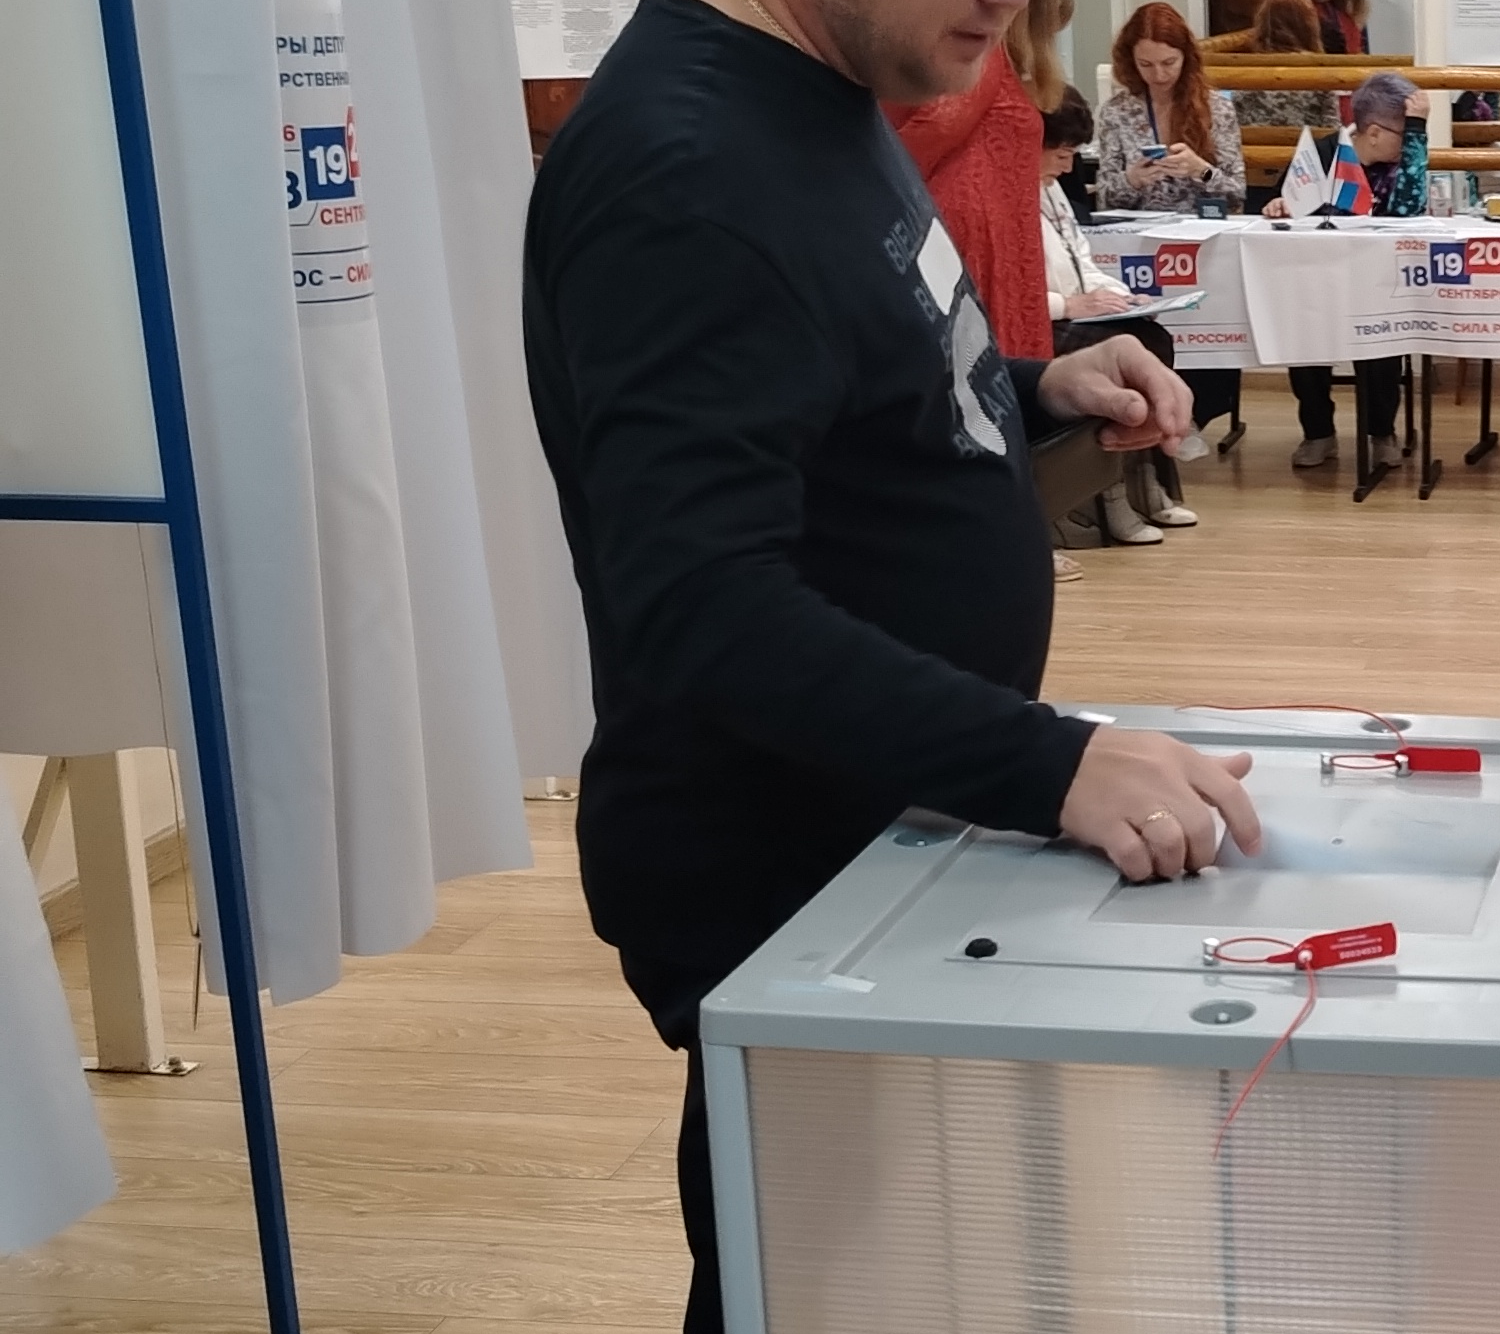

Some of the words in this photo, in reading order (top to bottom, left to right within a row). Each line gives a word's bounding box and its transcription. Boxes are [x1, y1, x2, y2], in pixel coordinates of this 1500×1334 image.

[309, 144, 347, 186] 19
[1395, 240, 1427, 251] 2026
[1124, 266, 1154, 289] 19
[1159, 253, 1194, 277] 20
[1402, 266, 1428, 287] 18
[1433, 252, 1463, 277] 19
[1188, 333, 1248, 345] РОССИИ!
[1354, 320, 1391, 336] ТВОЙ
[1394, 319, 1439, 332] ГОЛОС
[1453, 322, 1490, 334] СИЛА
